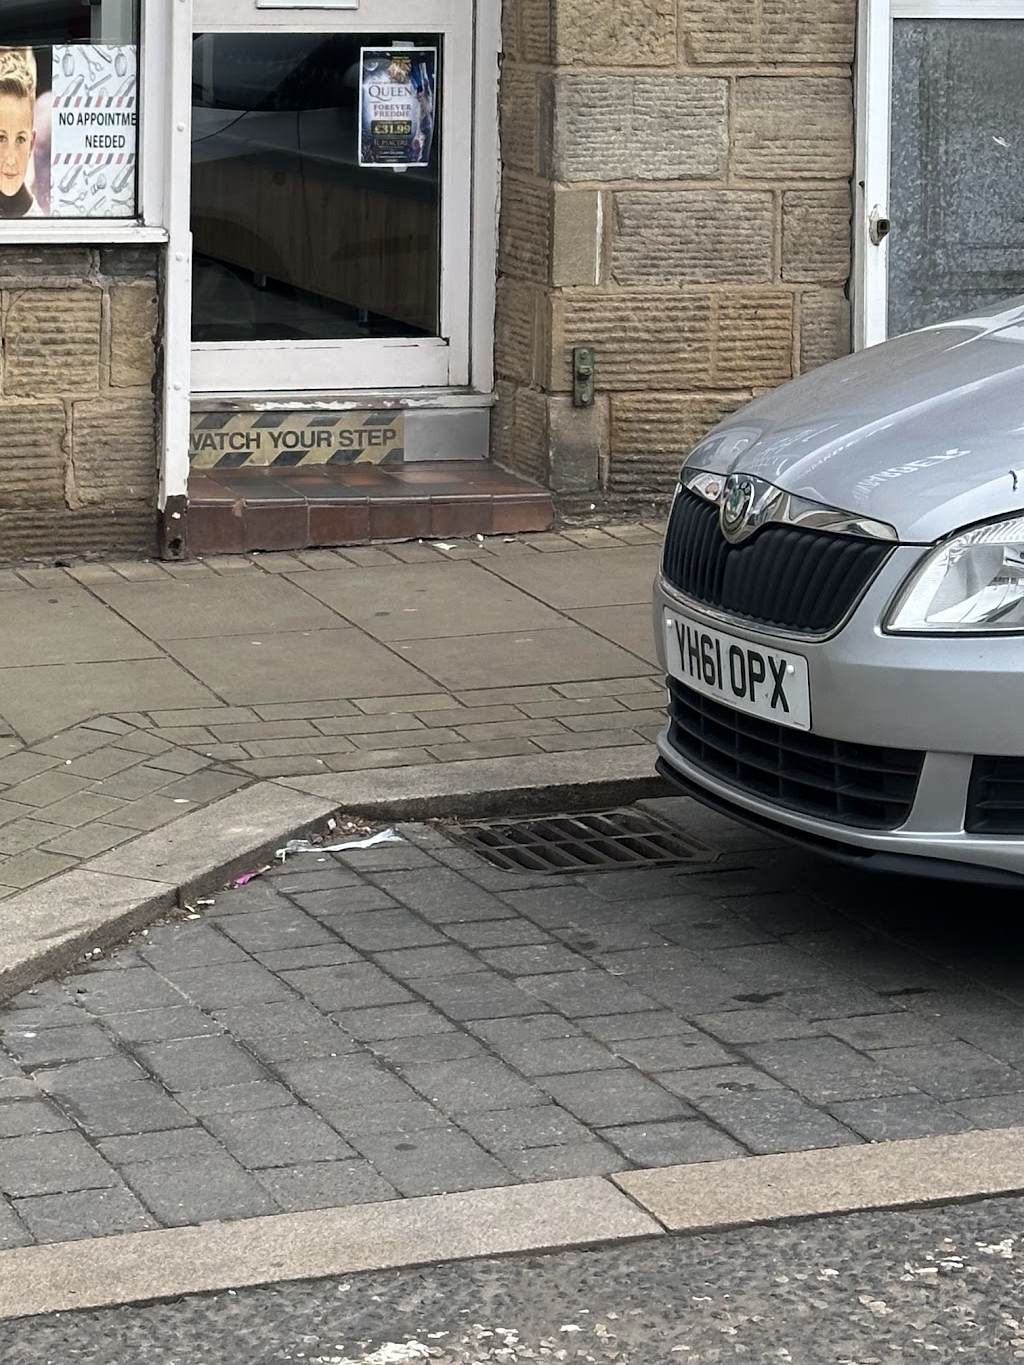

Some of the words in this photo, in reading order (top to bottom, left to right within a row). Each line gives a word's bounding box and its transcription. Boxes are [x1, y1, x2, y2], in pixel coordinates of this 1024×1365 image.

[368, 85, 412, 101] QUEEN
[59, 112, 74, 126] NO
[374, 124, 411, 134] £31.99
[85, 135, 125, 148] NEEDED
[267, 430, 332, 449] YOUR
[339, 428, 396, 447] STEP
[674, 620, 723, 690] YH61
[729, 644, 790, 713] OPX
